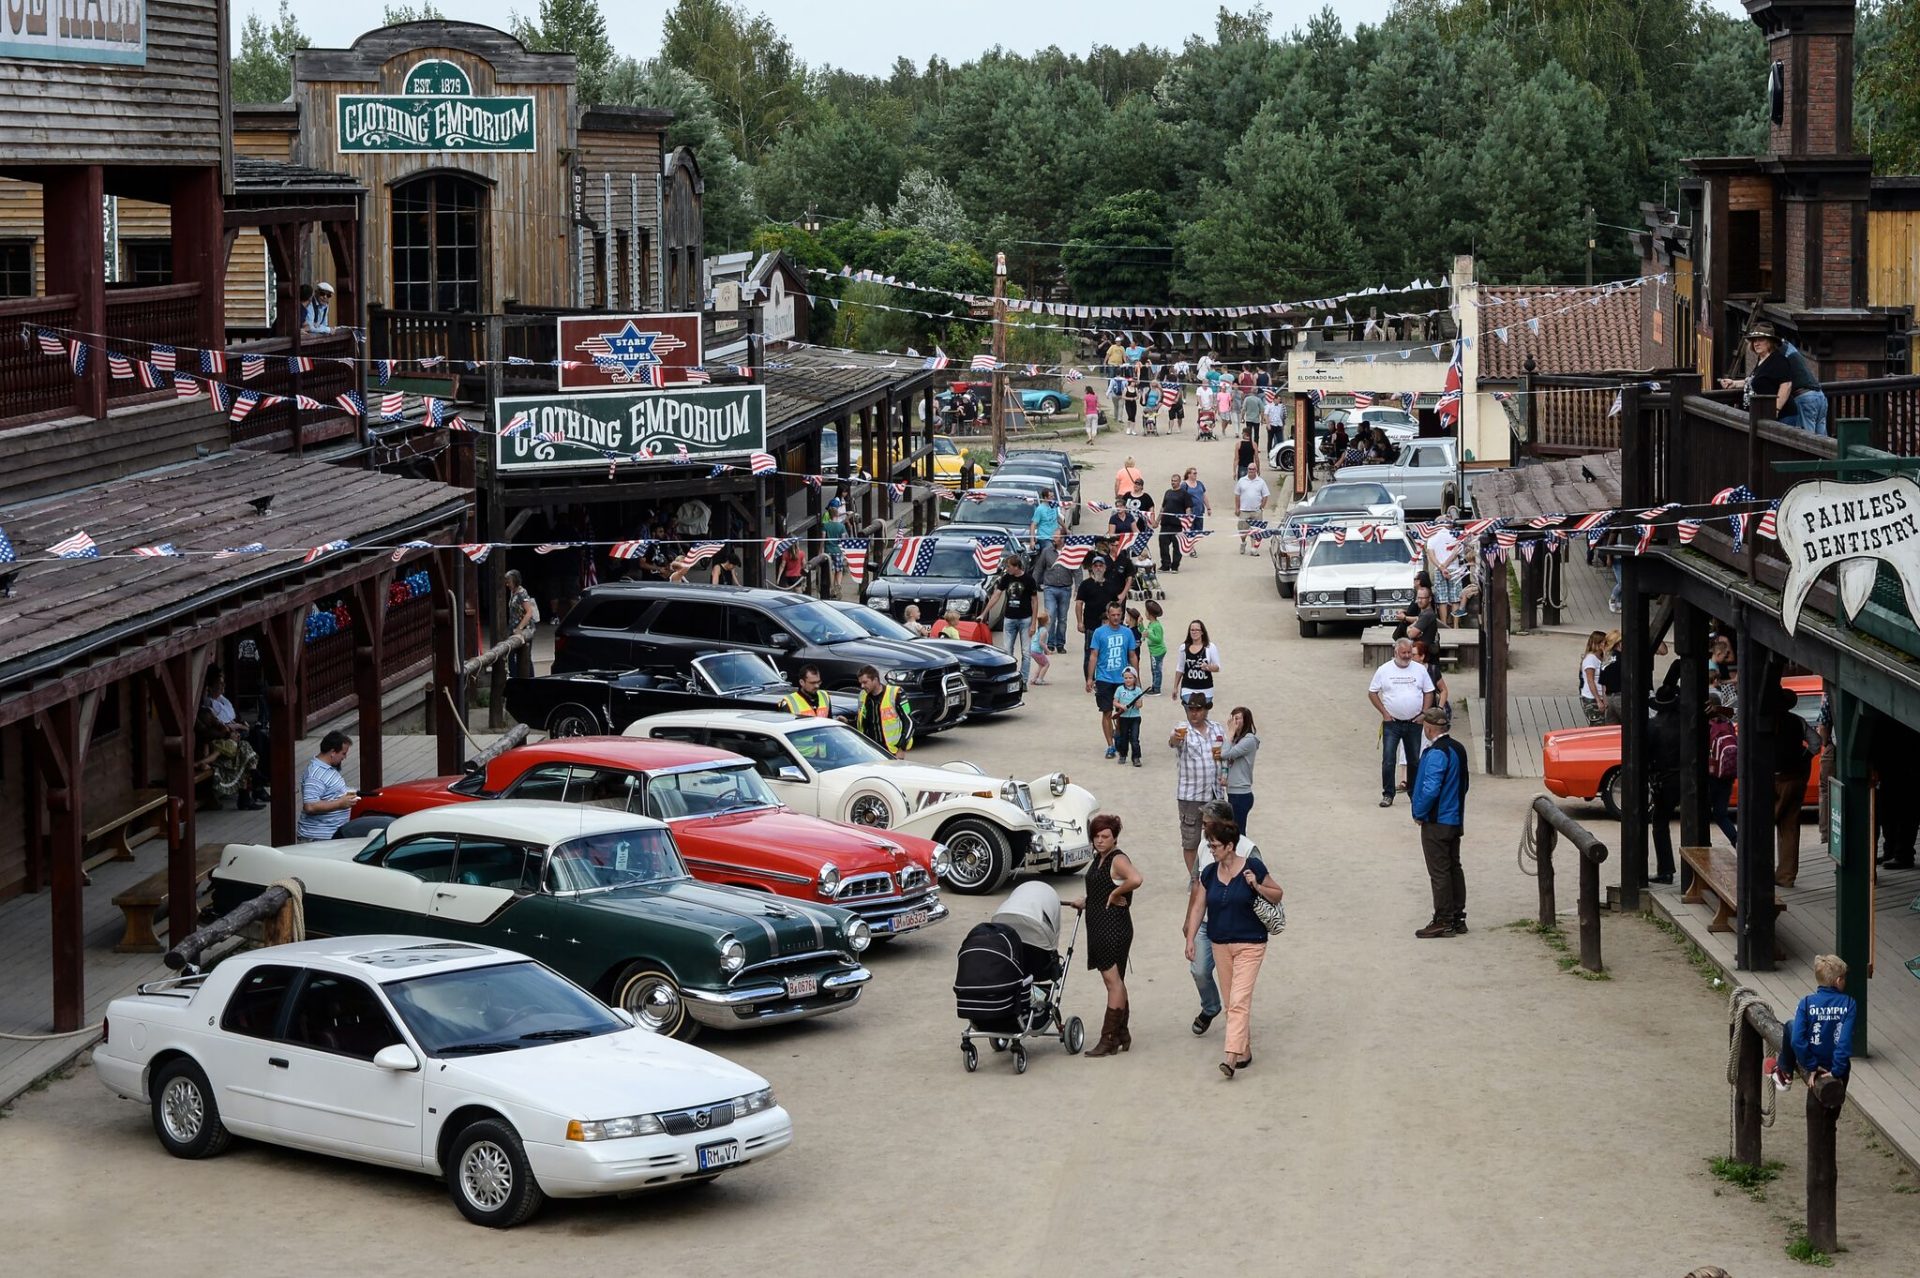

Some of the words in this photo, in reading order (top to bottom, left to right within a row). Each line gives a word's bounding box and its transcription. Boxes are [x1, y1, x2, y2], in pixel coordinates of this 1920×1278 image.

[413, 78, 434, 93] EST.
[441, 78, 461, 93] 1879
[345, 102, 430, 143] CLOTHING
[434, 100, 530, 142] EMPORIUM
[615, 338, 646, 346] STARS
[629, 394, 750, 446] EMPORIUM
[1803, 488, 1907, 534] PAINLESS
[1802, 513, 1919, 563] DENTISTRY
[1107, 635, 1123, 648] AD
[1109, 647, 1121, 658] ID
[1107, 658, 1122, 669] AS
[1187, 668, 1208, 680] COOL
[789, 982, 794, 993] B
[1809, 1006, 1848, 1015] OLYMPIA
[706, 1148, 720, 1166] RM
